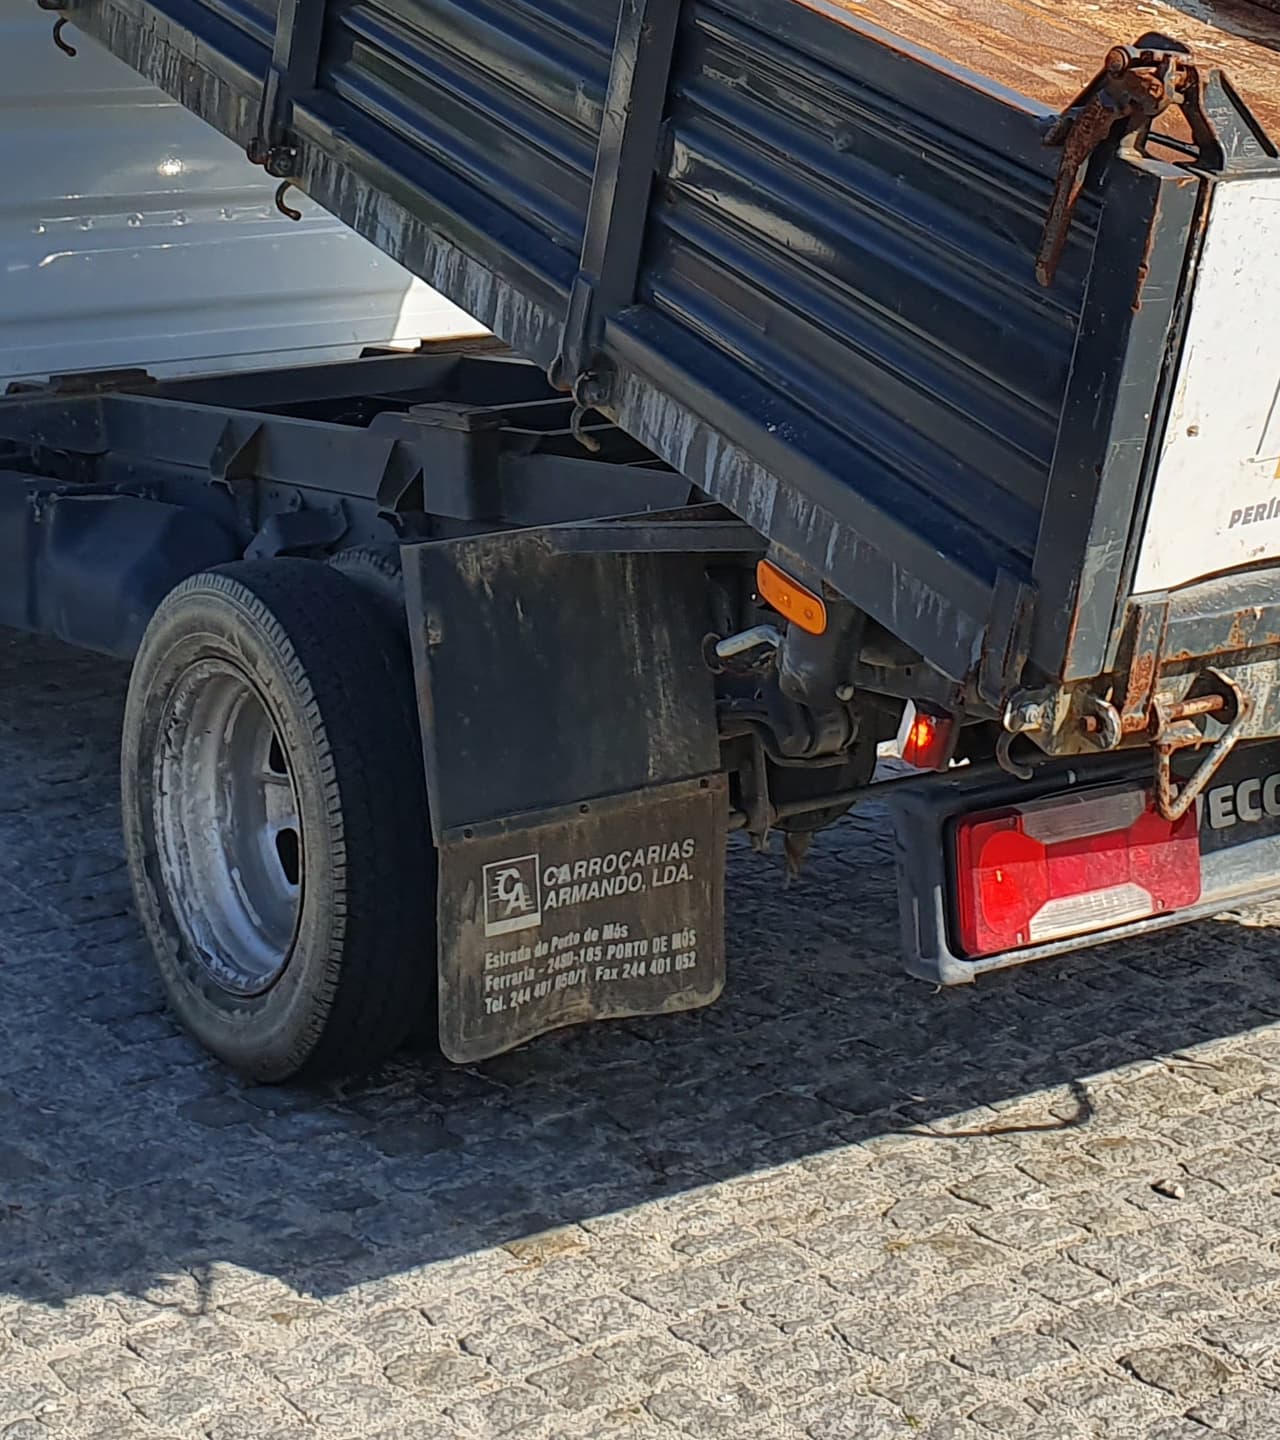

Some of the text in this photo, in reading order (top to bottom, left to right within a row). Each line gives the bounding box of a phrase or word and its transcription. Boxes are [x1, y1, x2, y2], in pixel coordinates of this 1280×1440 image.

[543, 838, 695, 887] CARROÇARIAS
[544, 862, 695, 911] ARMANDO, LDA.
[485, 944, 532, 971] Estrada
[551, 931, 581, 954] Porto
[584, 927, 599, 942] de
[602, 922, 629, 940] Mós
[485, 966, 535, 993] Ferraria
[606, 939, 649, 960] PORTO
[652, 936, 668, 953] DE
[671, 927, 697, 951] MÓS
[484, 996, 507, 1014] Tel.
[510, 986, 531, 1008] 244
[533, 979, 552, 999] 401
[595, 966, 619, 982] Fax
[622, 961, 646, 979] 244
[649, 957, 671, 974] 401
[675, 951, 697, 971] 052
